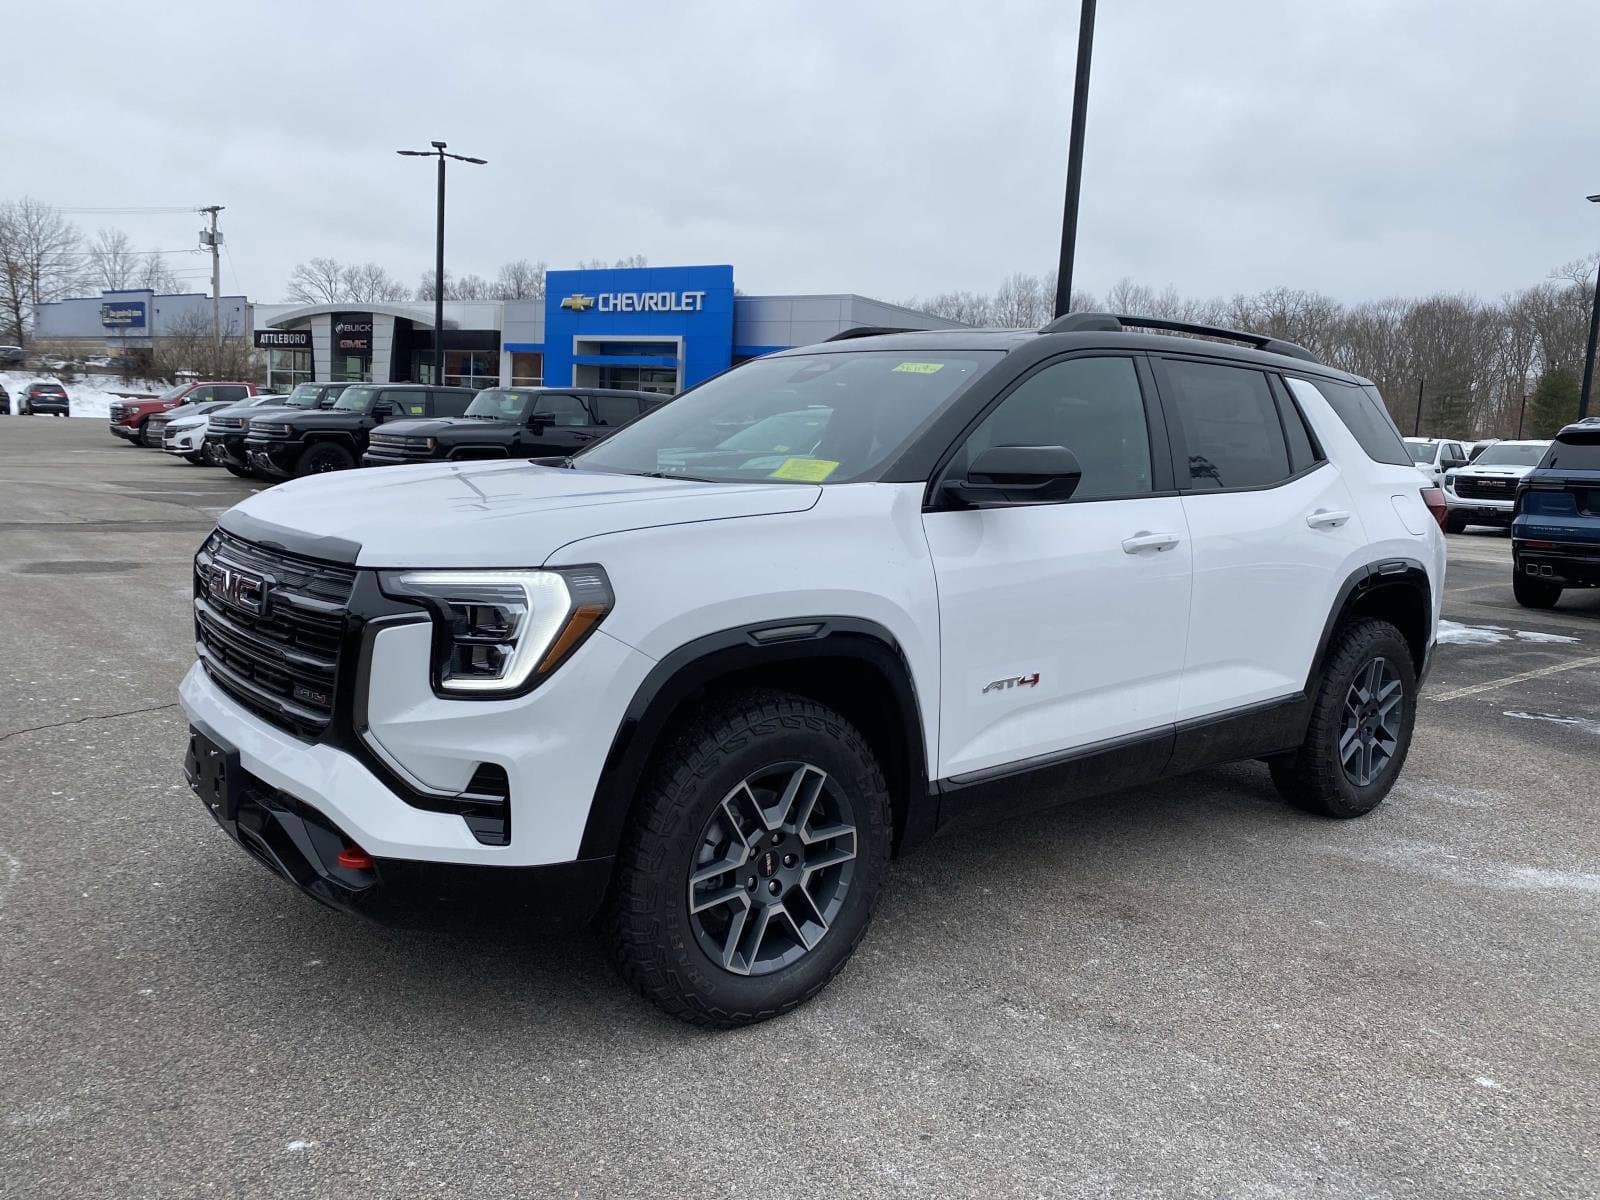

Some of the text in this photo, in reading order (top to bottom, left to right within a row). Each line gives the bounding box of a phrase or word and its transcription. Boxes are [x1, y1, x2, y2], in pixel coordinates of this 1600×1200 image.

[599, 291, 705, 312] CHEVROLET
[344, 324, 372, 332] BUICK
[260, 333, 306, 344] ATTLEBORO
[340, 340, 367, 349] GMC
[208, 563, 261, 614] GMC
[982, 672, 1040, 694] AT4
